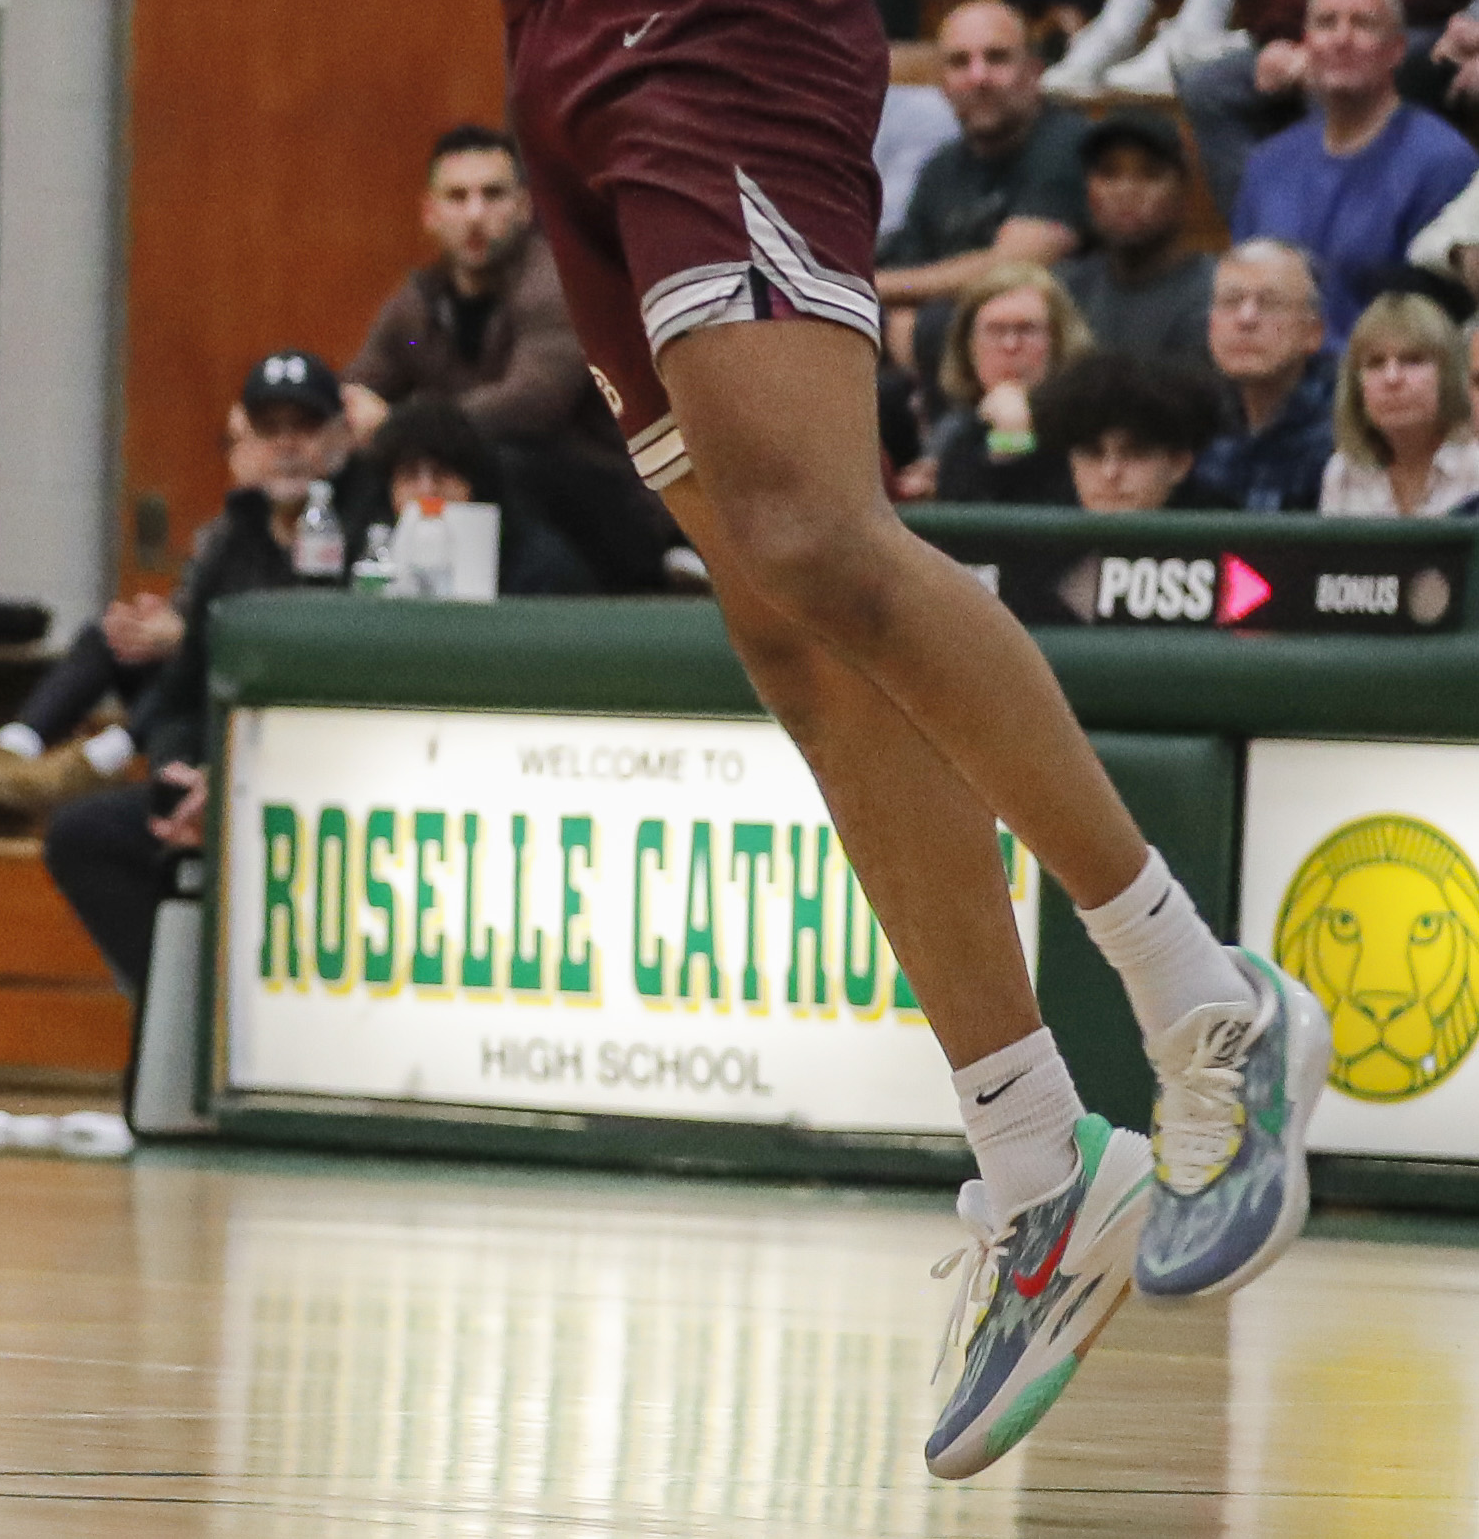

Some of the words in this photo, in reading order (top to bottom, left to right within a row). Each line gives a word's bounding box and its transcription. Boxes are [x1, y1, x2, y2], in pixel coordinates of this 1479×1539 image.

[1096, 556, 1215, 621] POSS
[1315, 572, 1400, 615] BONUS
[517, 743, 688, 784] WELCOME
[702, 748, 746, 785] TO
[260, 805, 603, 1007] ROSELLE
[633, 817, 1025, 1024] CATHO
[481, 1036, 583, 1084] HIGH
[596, 1039, 773, 1096] SCHOOL
